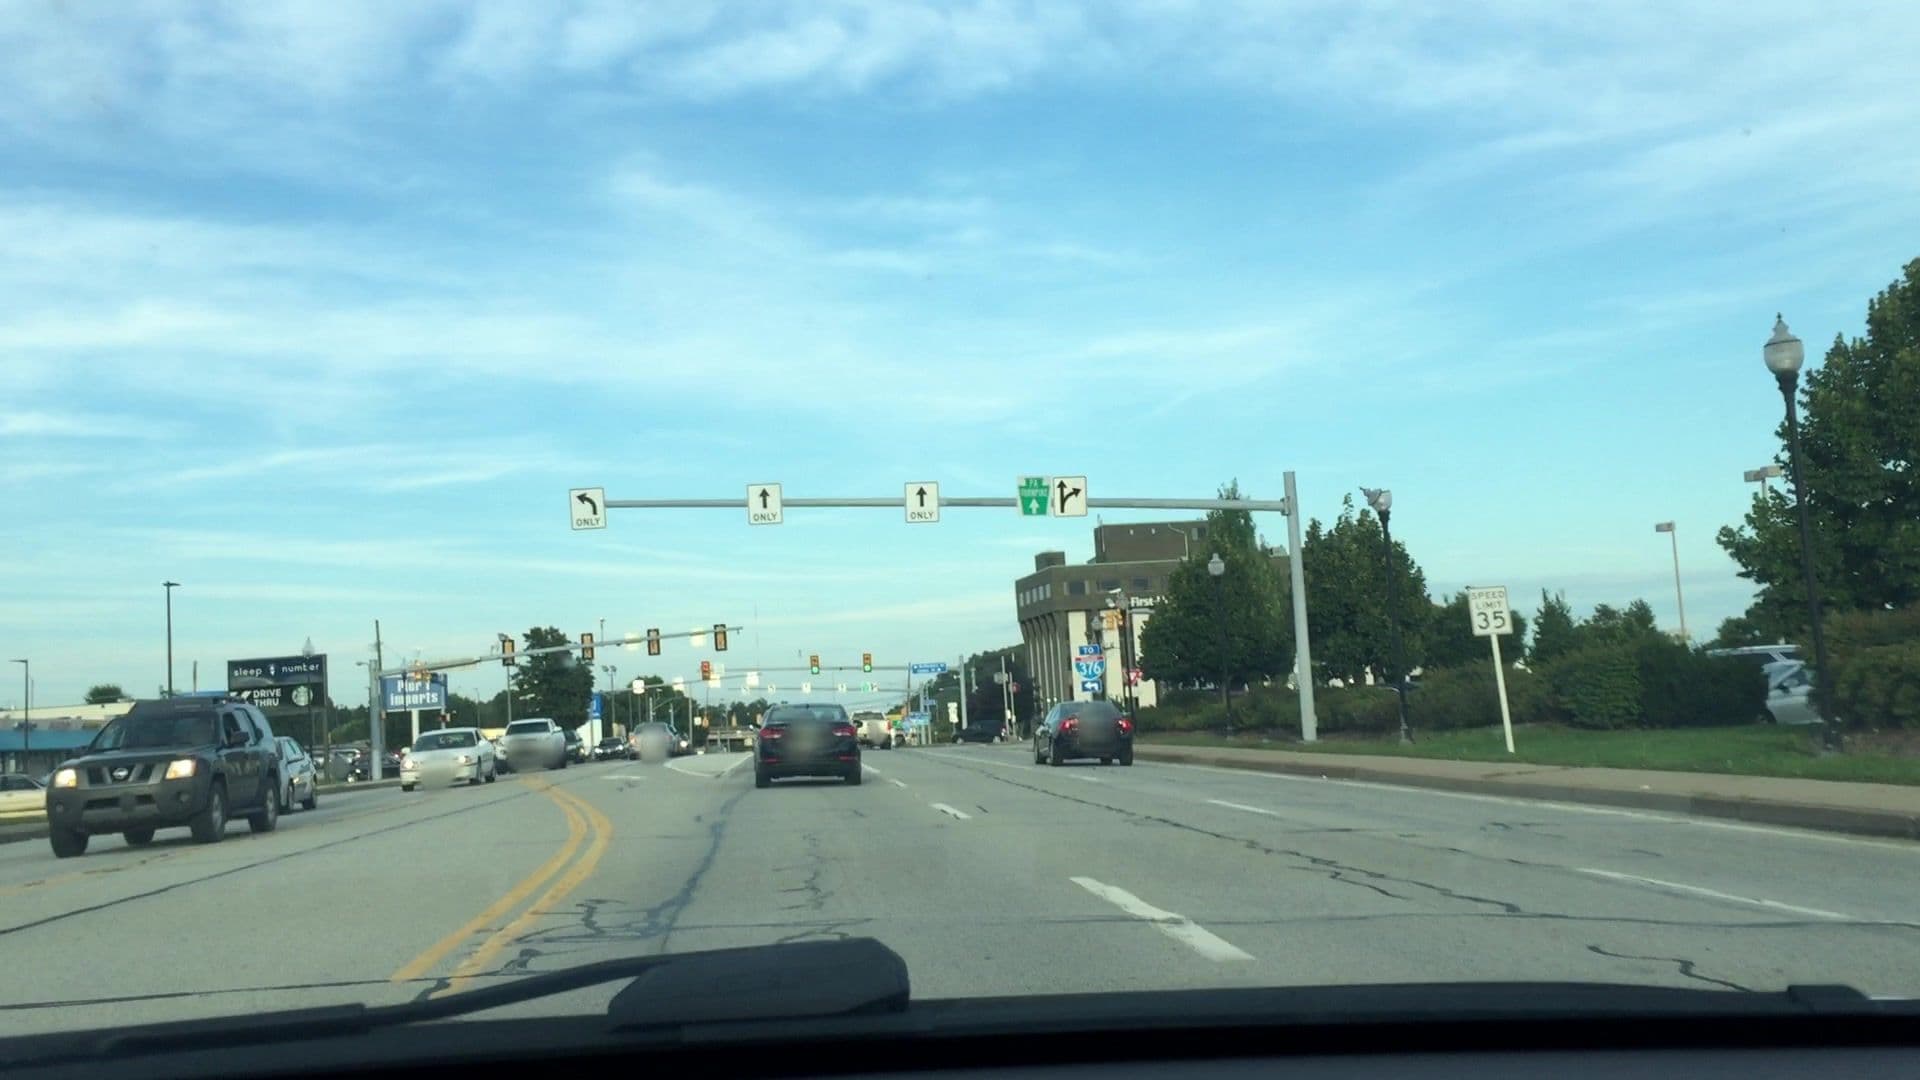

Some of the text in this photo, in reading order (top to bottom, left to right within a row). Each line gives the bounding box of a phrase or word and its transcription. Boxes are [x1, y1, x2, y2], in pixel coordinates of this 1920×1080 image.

[753, 512, 778, 522] ONLY
[910, 511, 934, 520] ONLY
[576, 517, 600, 527] ONLY
[1471, 590, 1505, 600] SPEED
[1130, 597, 1154, 607] First
[1475, 601, 1502, 610] LIMIT
[1477, 610, 1505, 629] 35
[1082, 646, 1094, 654] TO
[233, 668, 262, 677] sleep
[1079, 661, 1101, 675] 376
[253, 688, 282, 698] DRIVE
[254, 698, 280, 707] THRU
